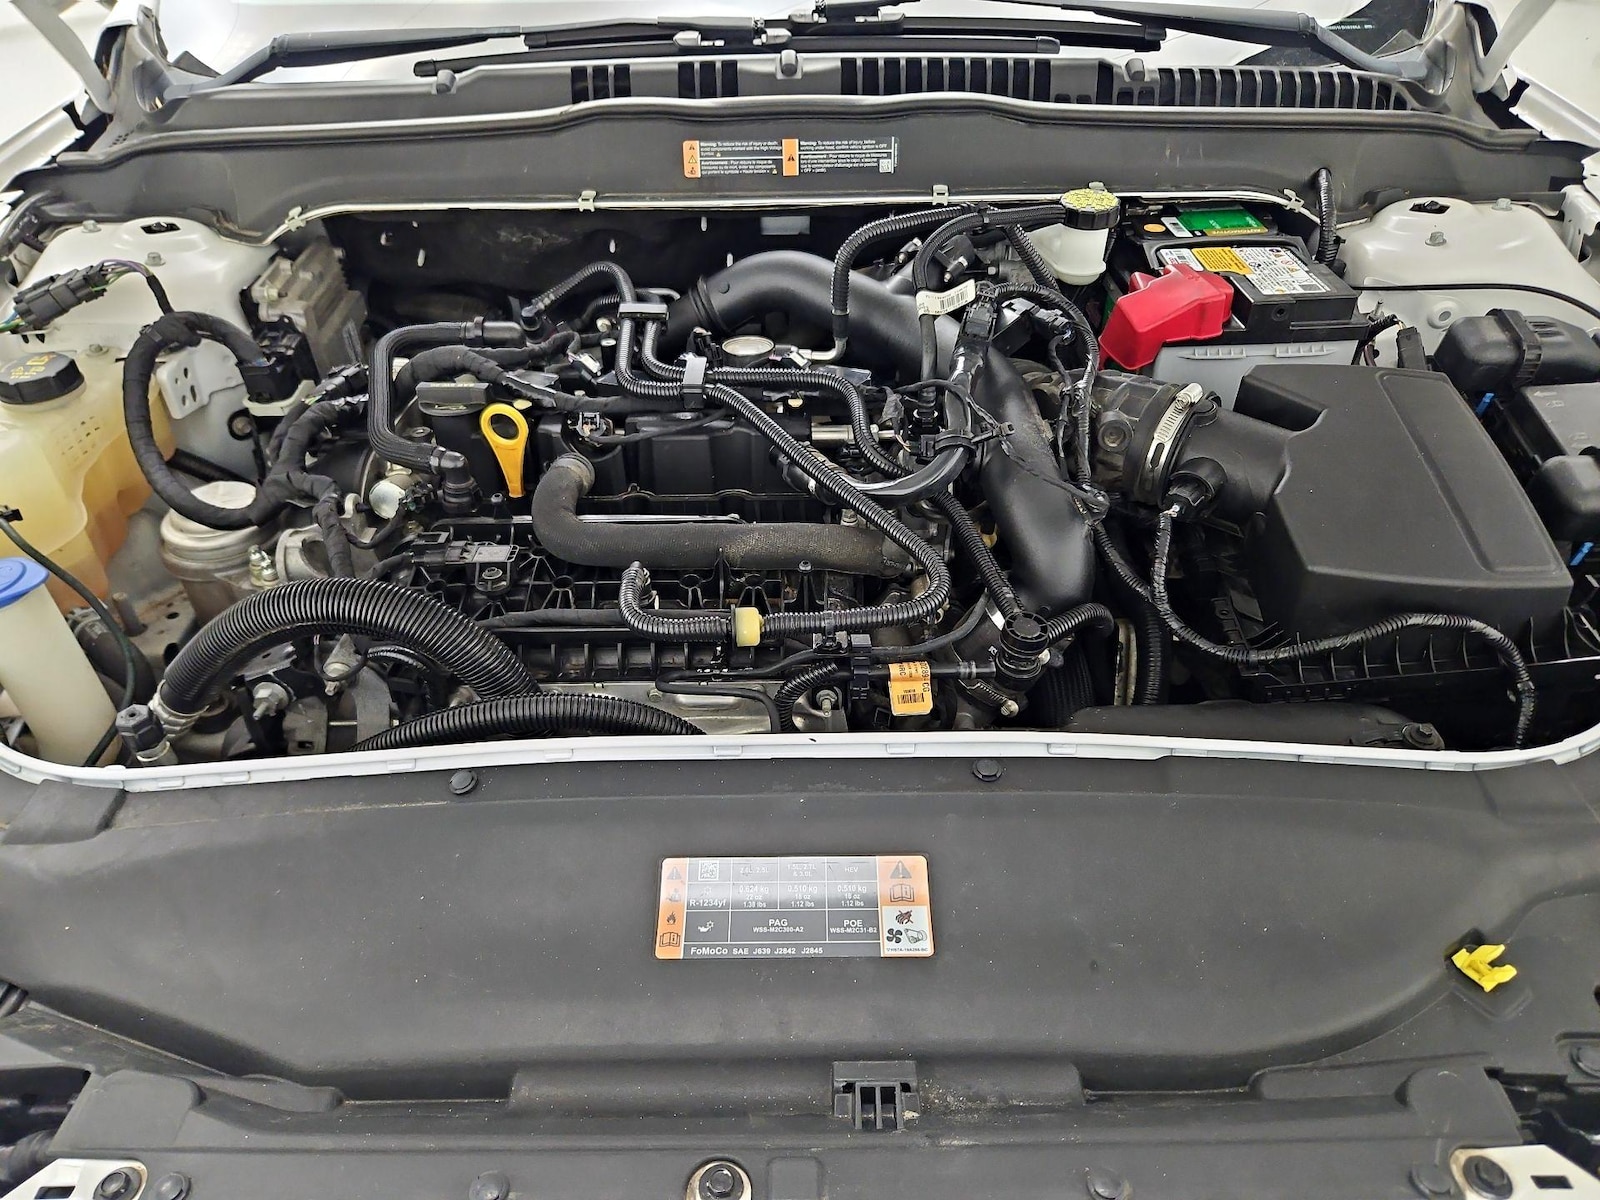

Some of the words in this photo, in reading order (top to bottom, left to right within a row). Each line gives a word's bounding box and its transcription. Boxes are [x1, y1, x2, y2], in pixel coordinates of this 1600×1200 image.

[808, 885, 818, 893] kg
[858, 885, 867, 893] kg
[690, 899, 726, 908] R-1234yf
